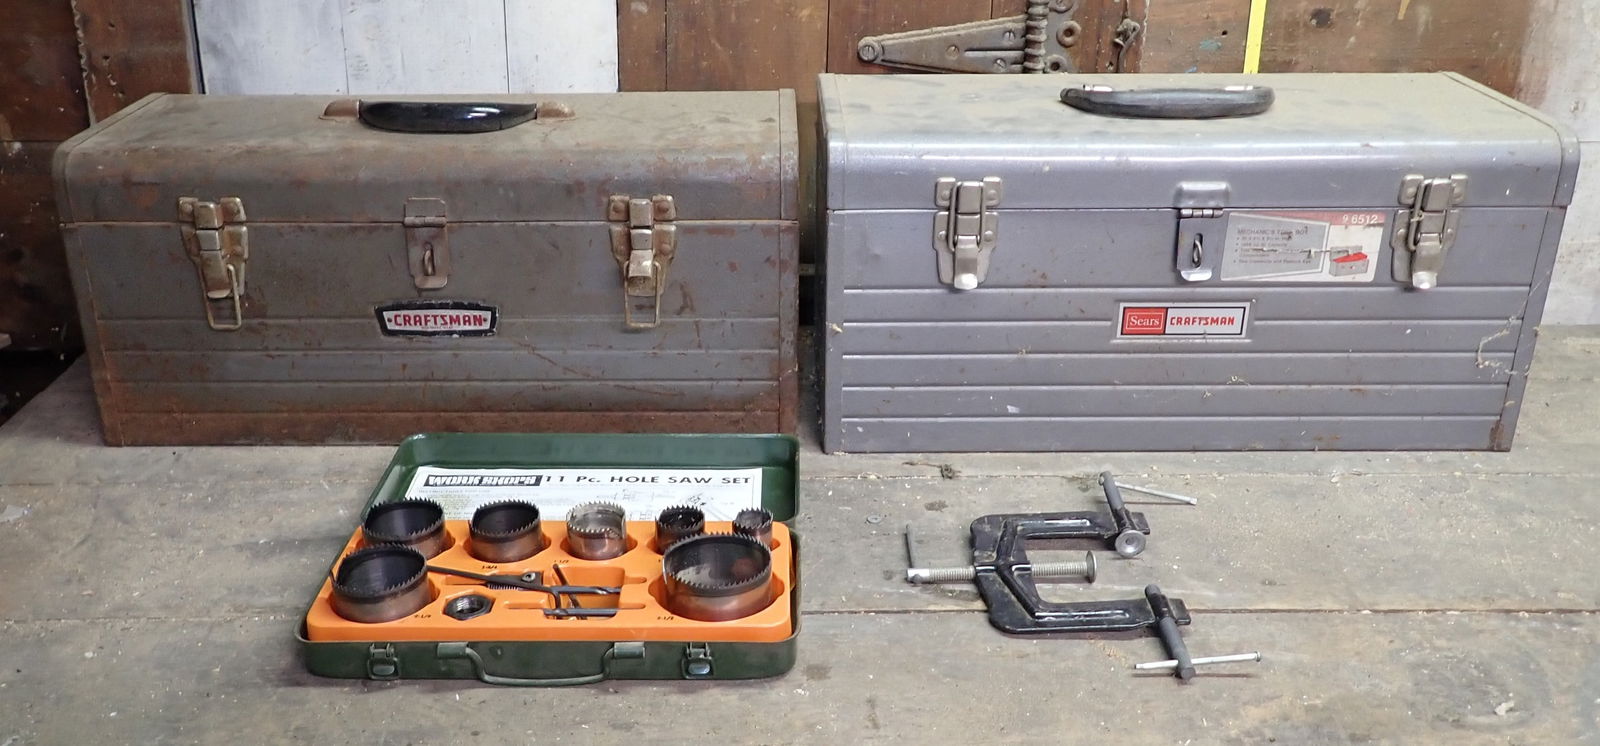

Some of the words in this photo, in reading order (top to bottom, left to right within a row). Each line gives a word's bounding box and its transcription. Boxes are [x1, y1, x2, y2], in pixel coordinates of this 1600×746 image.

[1343, 214, 1349, 224] 9
[1351, 214, 1378, 224] 6512
[393, 314, 483, 326] CRAFTSMAN
[1129, 315, 1160, 326] Sears
[1169, 316, 1235, 326] CRAFTSMAN
[576, 475, 601, 483] Pc.
[610, 475, 660, 483] HOLE
[667, 476, 712, 484] SAW
